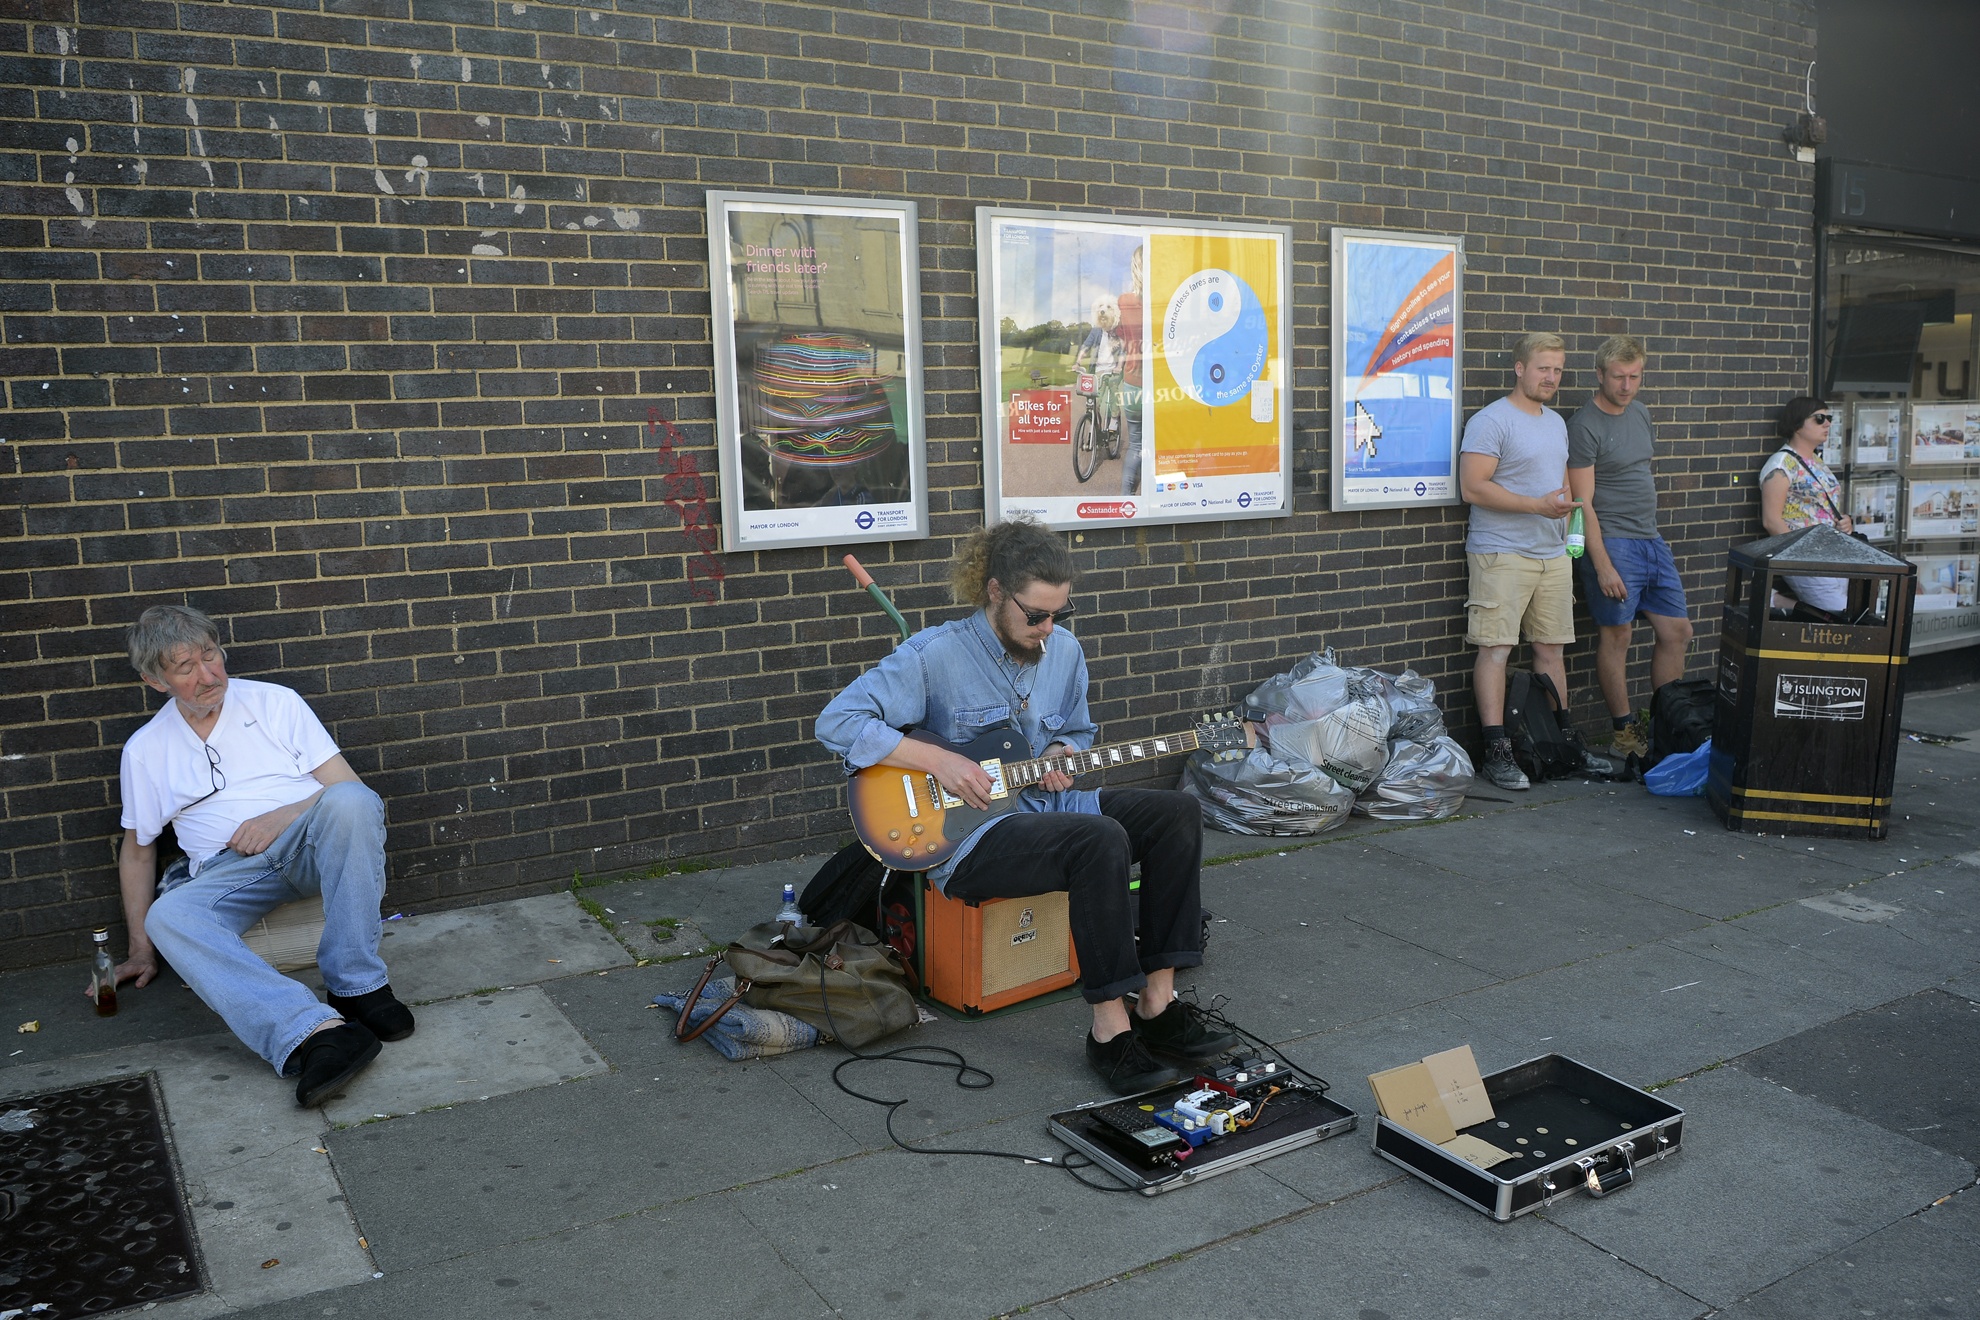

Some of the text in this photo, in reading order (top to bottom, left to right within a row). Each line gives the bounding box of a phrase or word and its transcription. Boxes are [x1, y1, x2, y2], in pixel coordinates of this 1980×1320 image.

[746, 244, 817, 258] Dinner with
[746, 261, 828, 274] friends later?
[1168, 276, 1220, 340] Contactless fares are
[1390, 271, 1451, 333] Sign up online to see your
[1396, 304, 1450, 345] contactless travel
[1391, 338, 1450, 366] history and spending
[1216, 390, 1228, 399] the
[1229, 381, 1248, 397] same
[1246, 372, 1254, 383] as
[1251, 344, 1264, 373] Oyster
[1018, 400, 1045, 411] Bikes
[1046, 400, 1062, 411] for
[1018, 414, 1061, 427] all types
[1086, 505, 1118, 514] Santander
[1800, 627, 1853, 646] Litter
[1794, 684, 1861, 697] ISLINGTON
[1320, 759, 1346, 778] Street
[1263, 797, 1339, 813] Street cleansing
